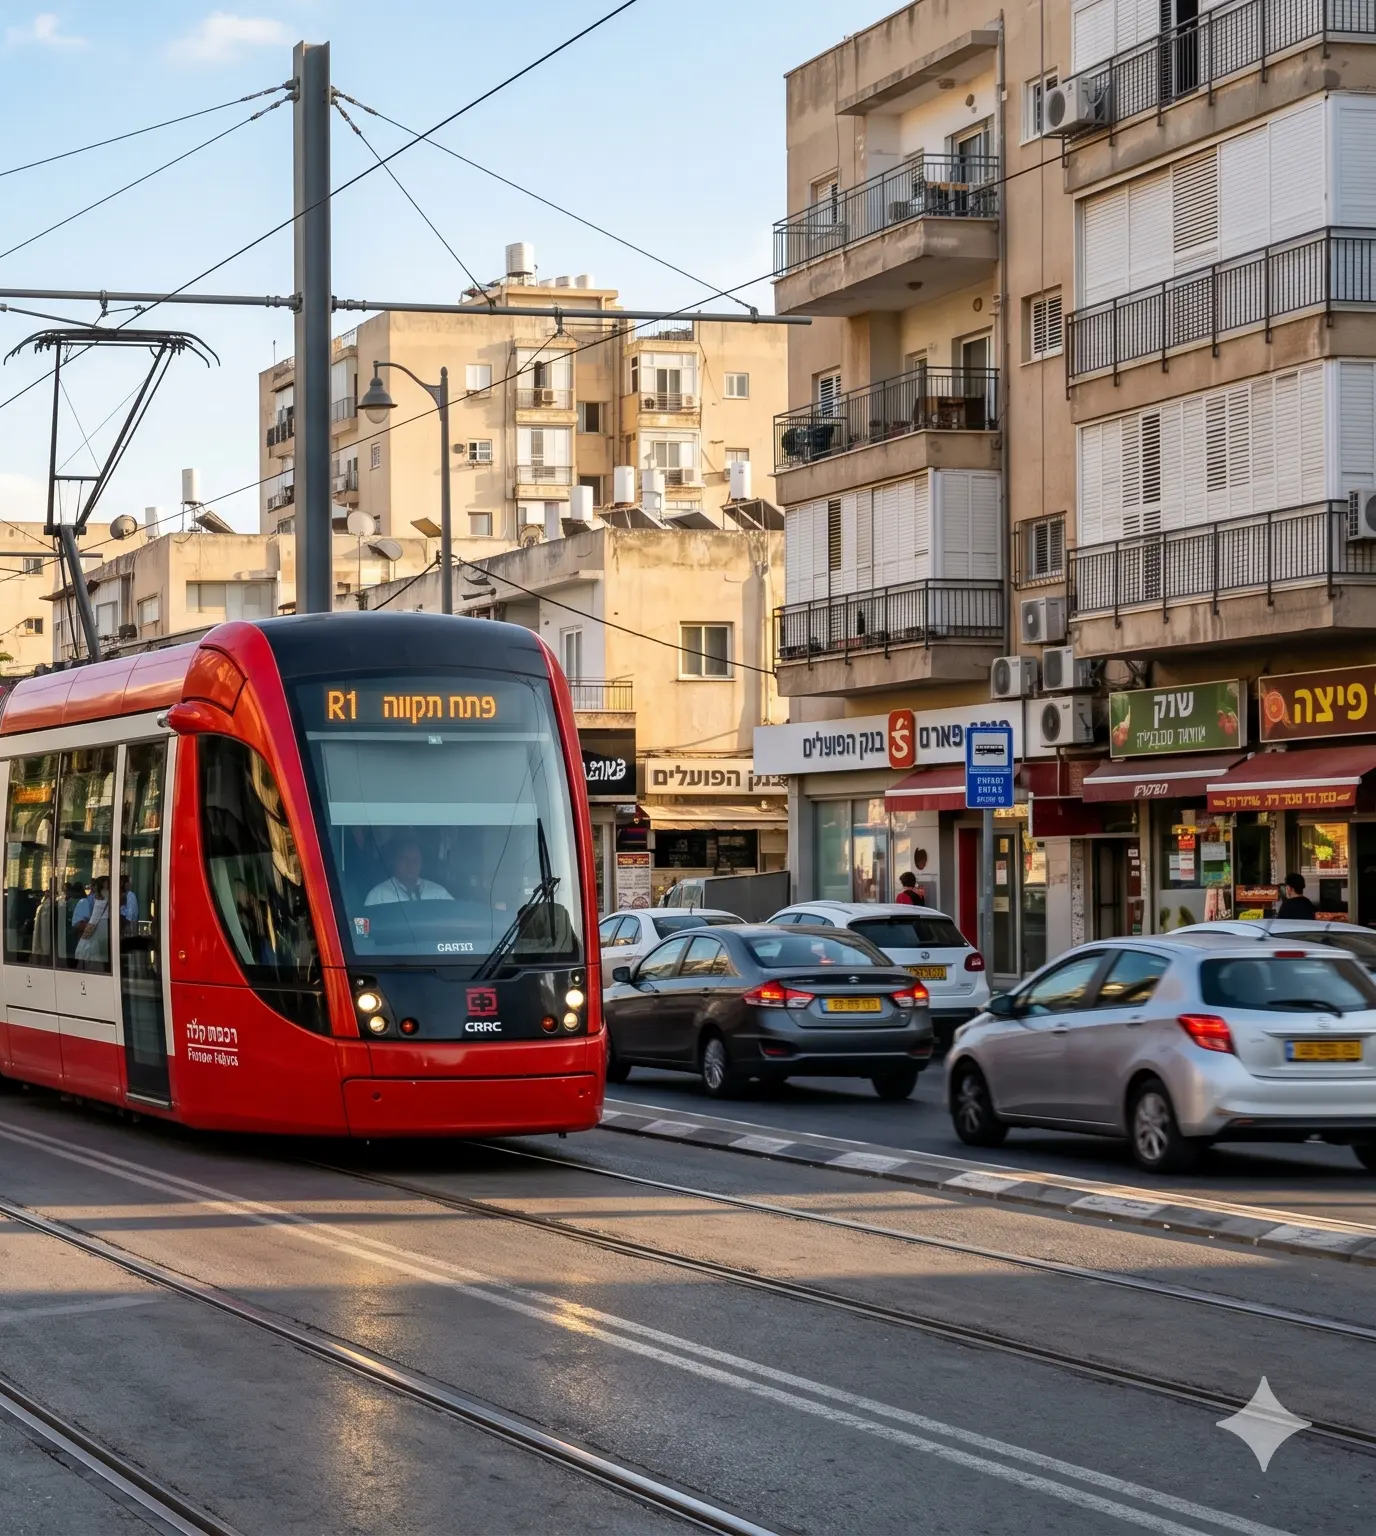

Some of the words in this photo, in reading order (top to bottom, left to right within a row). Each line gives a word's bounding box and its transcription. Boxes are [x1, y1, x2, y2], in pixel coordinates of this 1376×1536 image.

[327, 690, 357, 720] R1
[383, 695, 443, 724] תקווה
[448, 695, 497, 718] פתח
[1154, 692, 1194, 729] שוק
[1294, 683, 1368, 724] פיצה
[803, 731, 856, 758] הפועלים
[859, 731, 885, 760] בנק
[919, 724, 964, 749] פארם
[653, 765, 741, 787] הפועלים
[465, 1022, 502, 1032] CRRC
